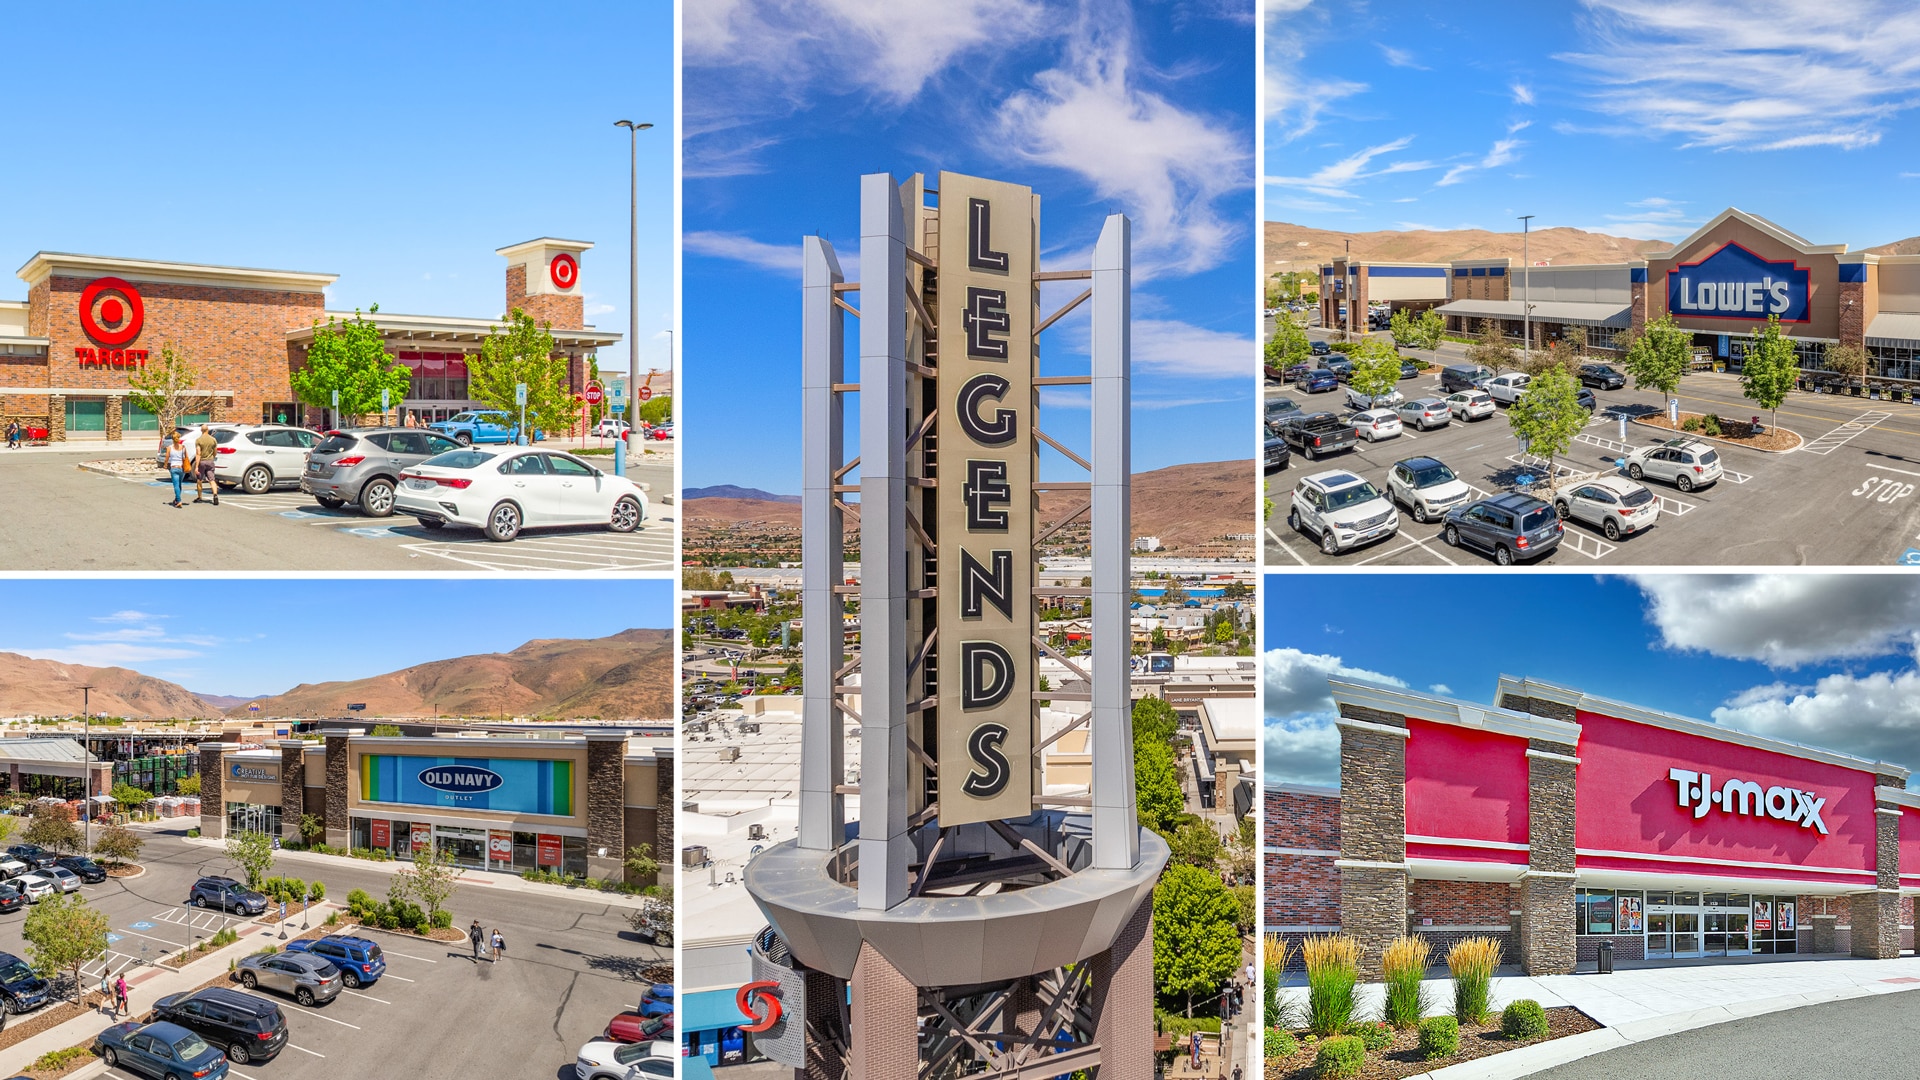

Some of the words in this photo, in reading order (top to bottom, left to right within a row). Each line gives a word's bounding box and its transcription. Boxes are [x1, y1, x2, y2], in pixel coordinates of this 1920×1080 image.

[1681, 276, 1789, 313] LOWE'S
[75, 347, 149, 368] TARGET
[586, 391, 601, 400] STOP
[955, 197, 1017, 799] LEGENDS
[1852, 477, 1915, 504] STOP
[236, 767, 265, 775] CREATIVE
[425, 771, 452, 785] OLD
[454, 772, 494, 787] NAVY
